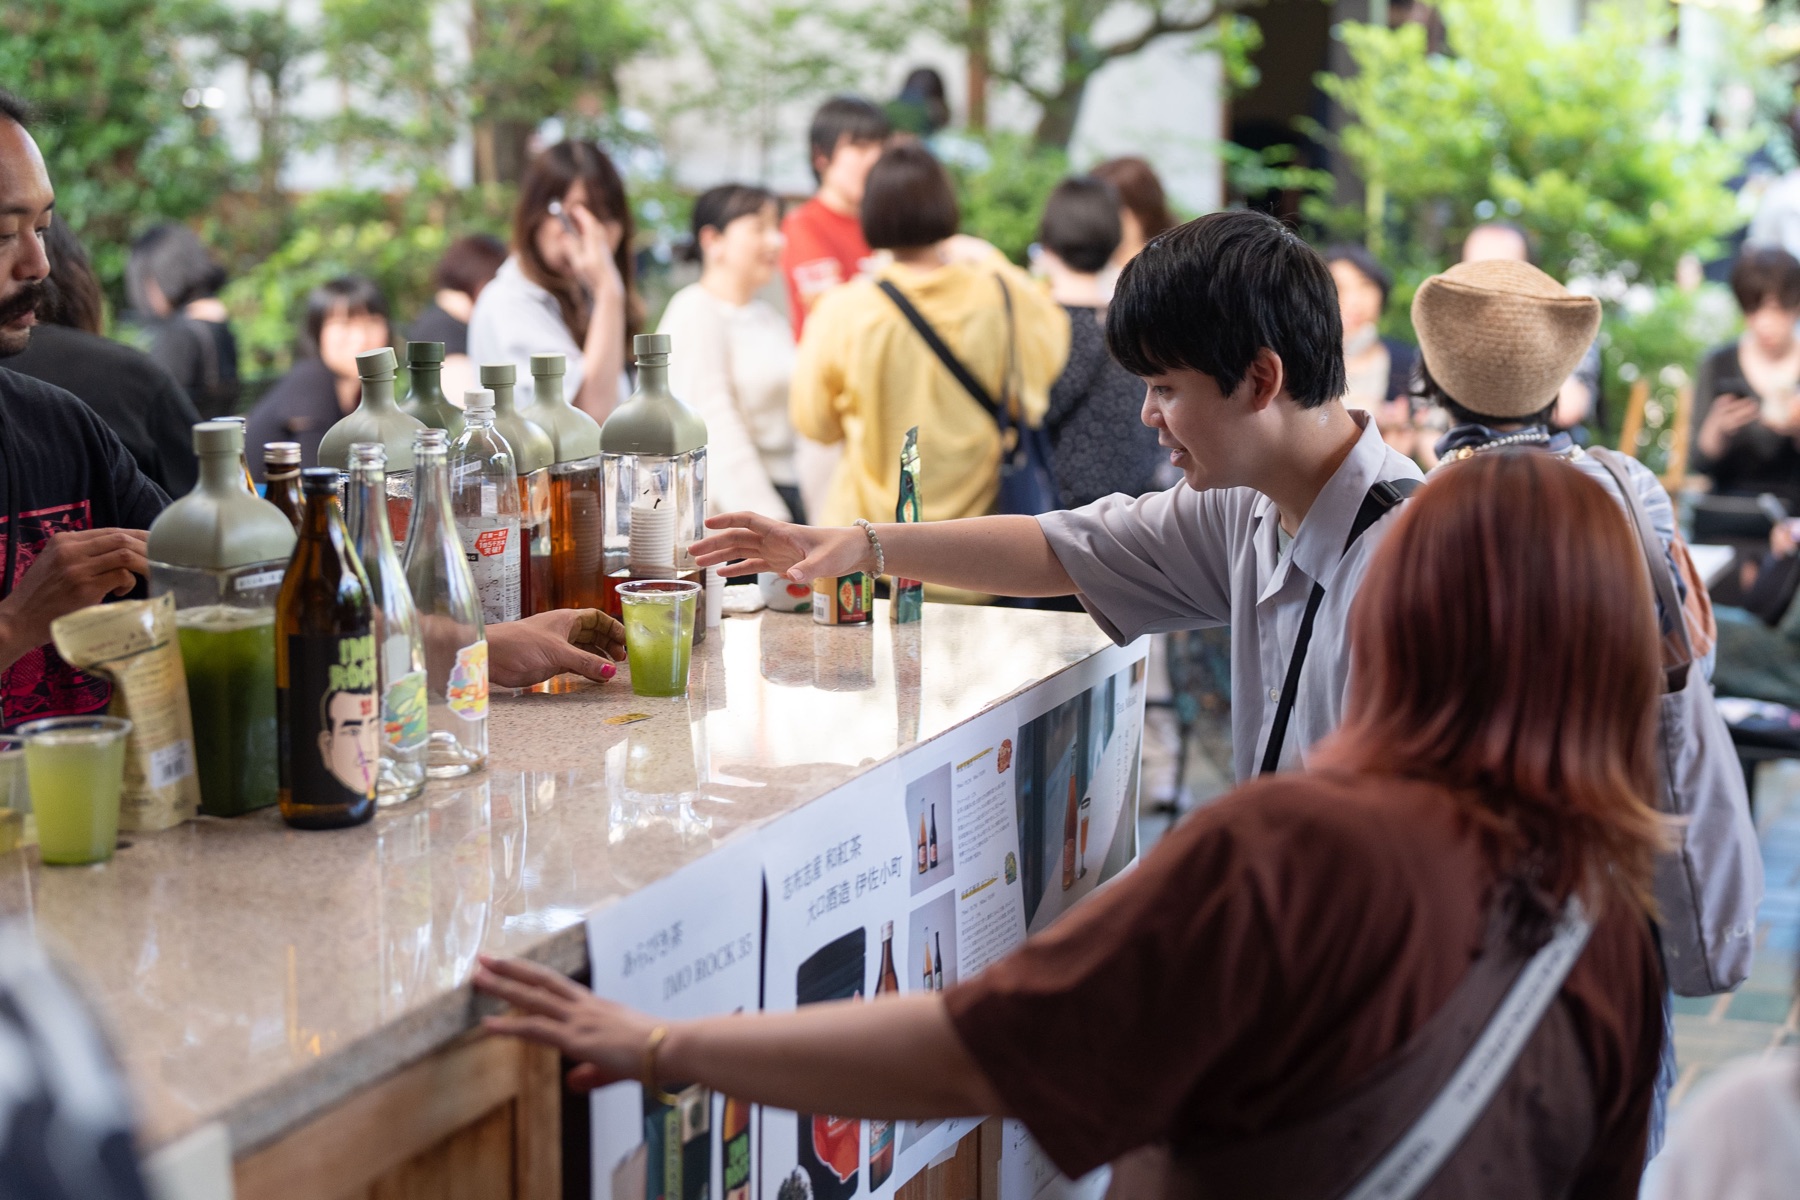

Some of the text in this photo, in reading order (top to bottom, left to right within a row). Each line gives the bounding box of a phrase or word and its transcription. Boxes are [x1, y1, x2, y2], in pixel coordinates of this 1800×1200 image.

[825, 834, 862, 871] 和紅茶
[806, 855, 903, 927] 大口酒造 伊佐小町
[662, 964, 693, 1002] IMO
[694, 941, 736, 984] ROCK
